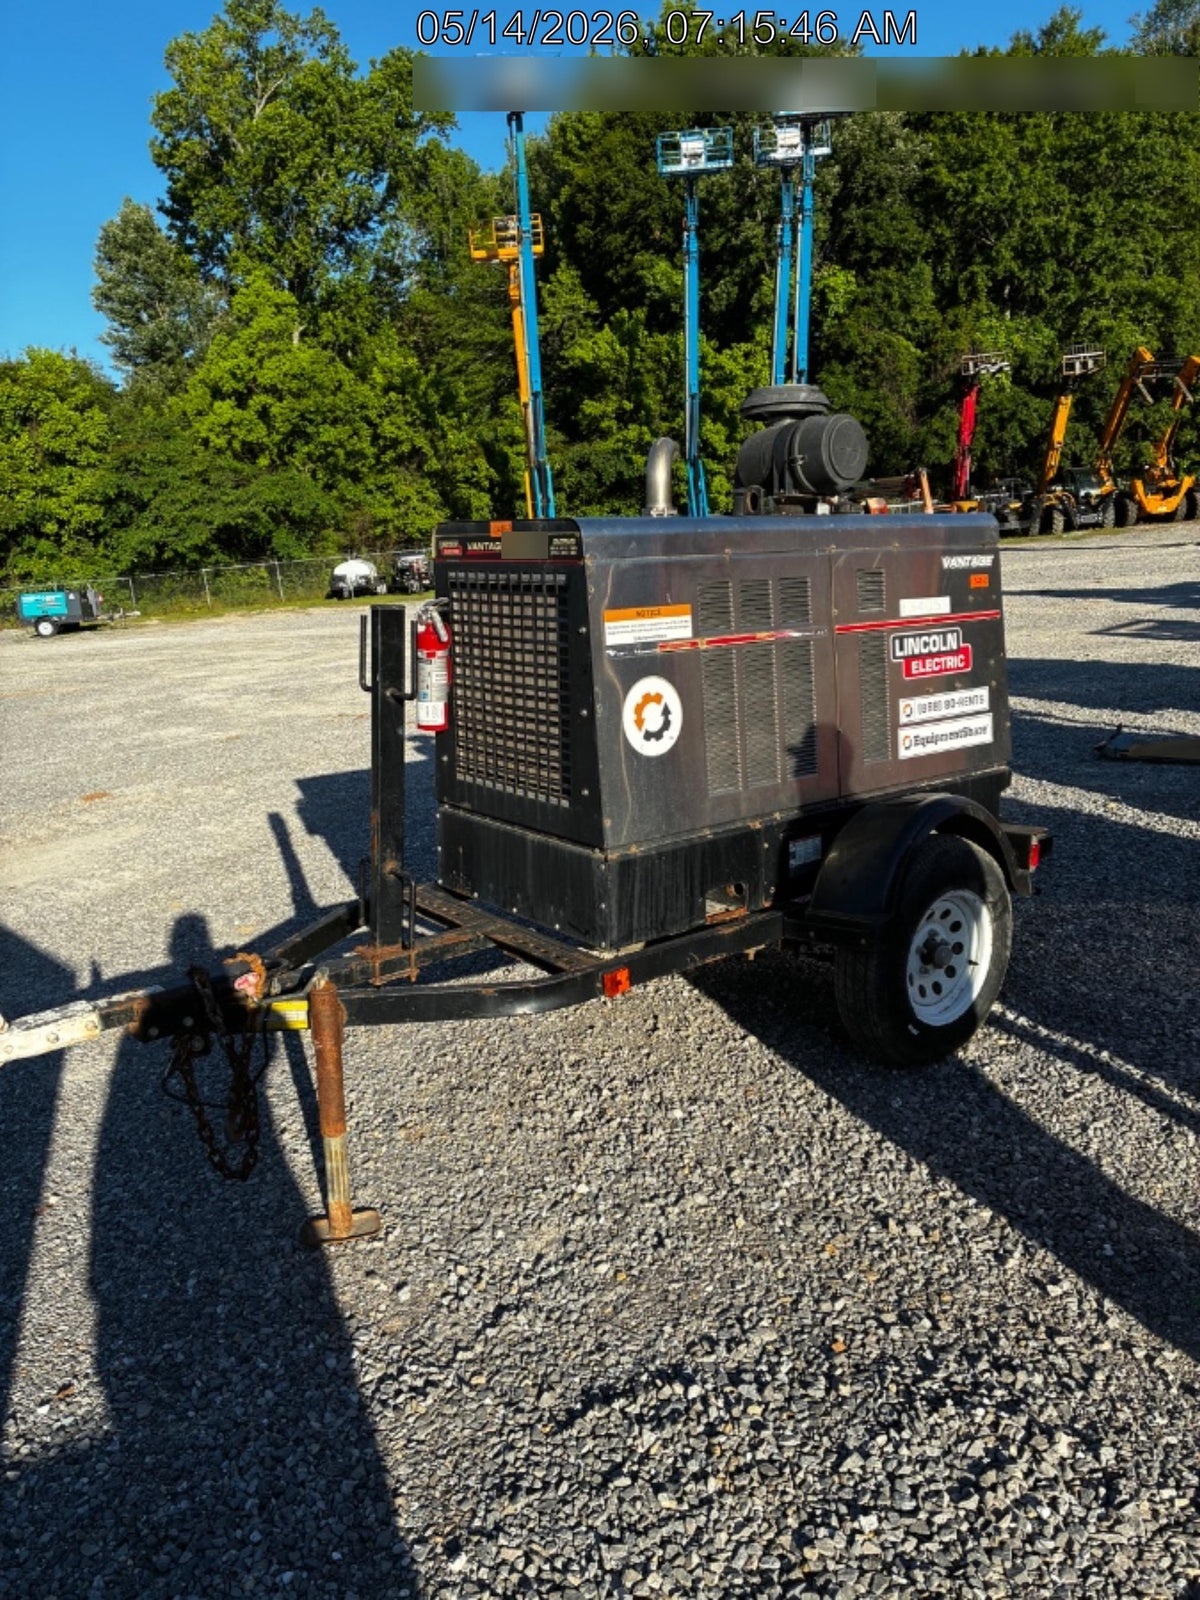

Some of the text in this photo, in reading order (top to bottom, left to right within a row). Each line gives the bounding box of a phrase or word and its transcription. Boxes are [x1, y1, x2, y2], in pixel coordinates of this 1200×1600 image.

[941, 554, 995, 570] VANTAGE
[895, 633, 958, 657] LINCOLN
[911, 655, 966, 675] ELECTRIC
[913, 726, 987, 748] EquipmentShare
